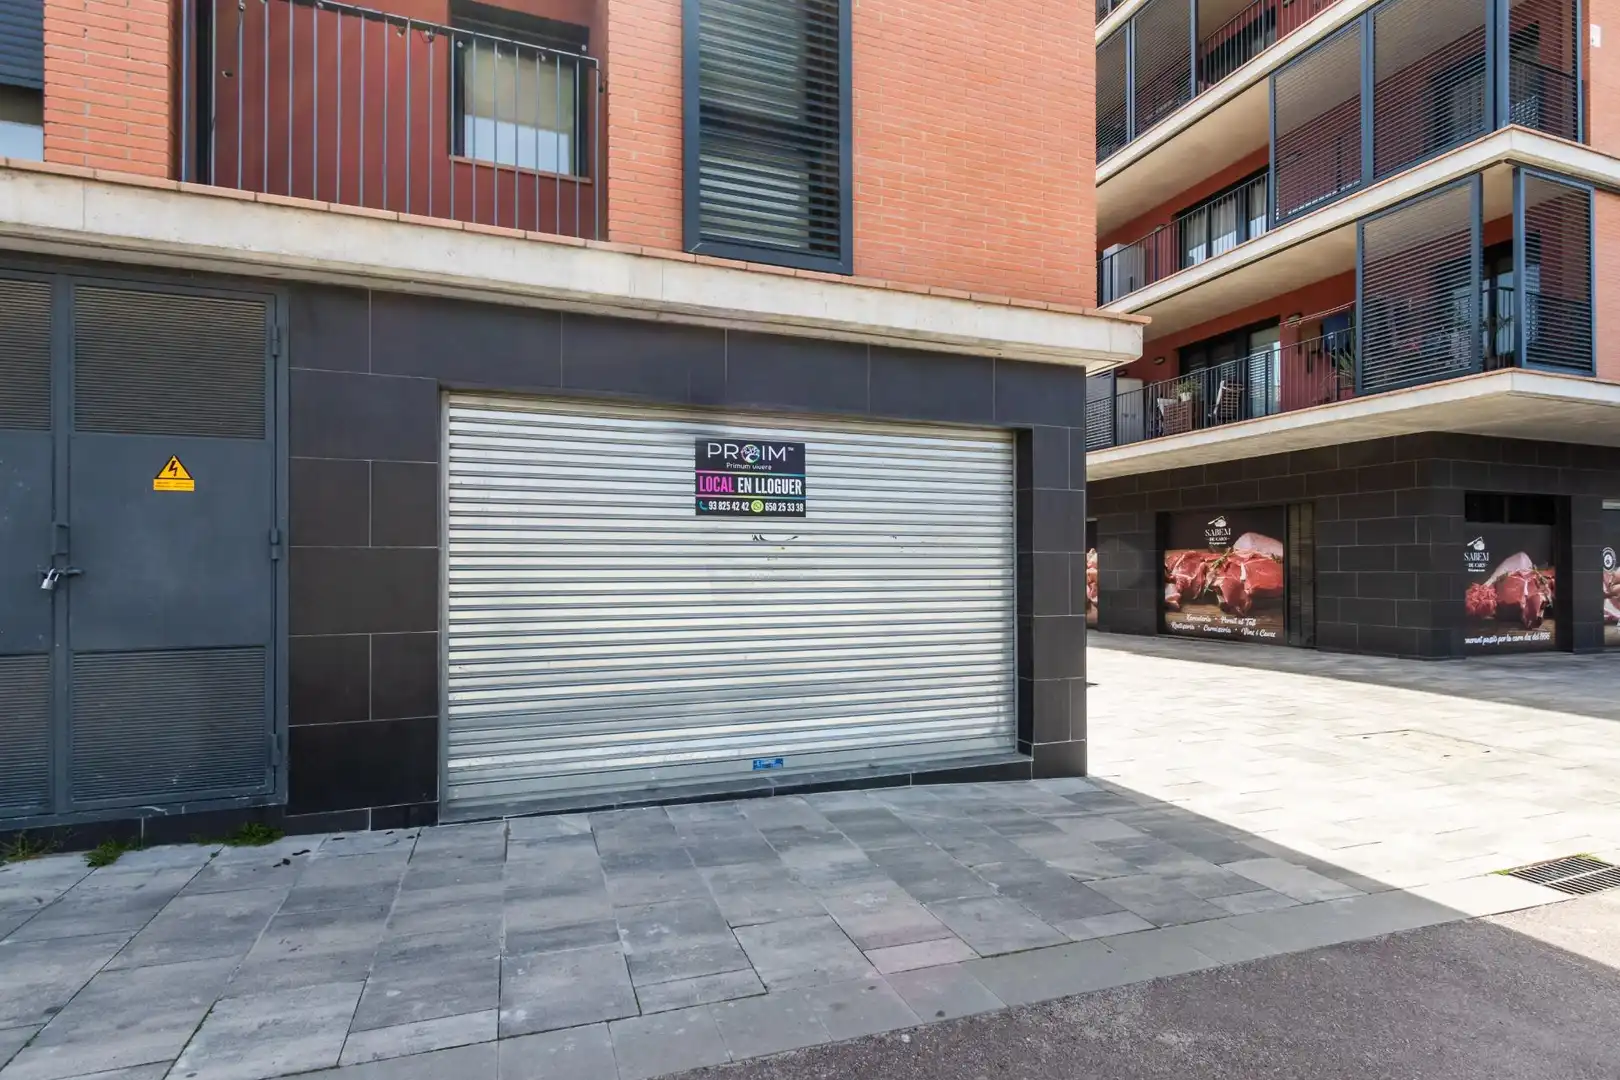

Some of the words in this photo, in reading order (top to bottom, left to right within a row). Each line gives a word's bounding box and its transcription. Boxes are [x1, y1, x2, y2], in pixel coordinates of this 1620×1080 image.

[699, 476, 735, 493] LOCAL
[737, 477, 752, 493] EN
[755, 478, 802, 495] LLOGUER
[708, 501, 717, 510] 93
[718, 501, 731, 511] 825
[731, 501, 740, 511] 42
[741, 502, 750, 511] 42
[777, 502, 786, 512] 25
